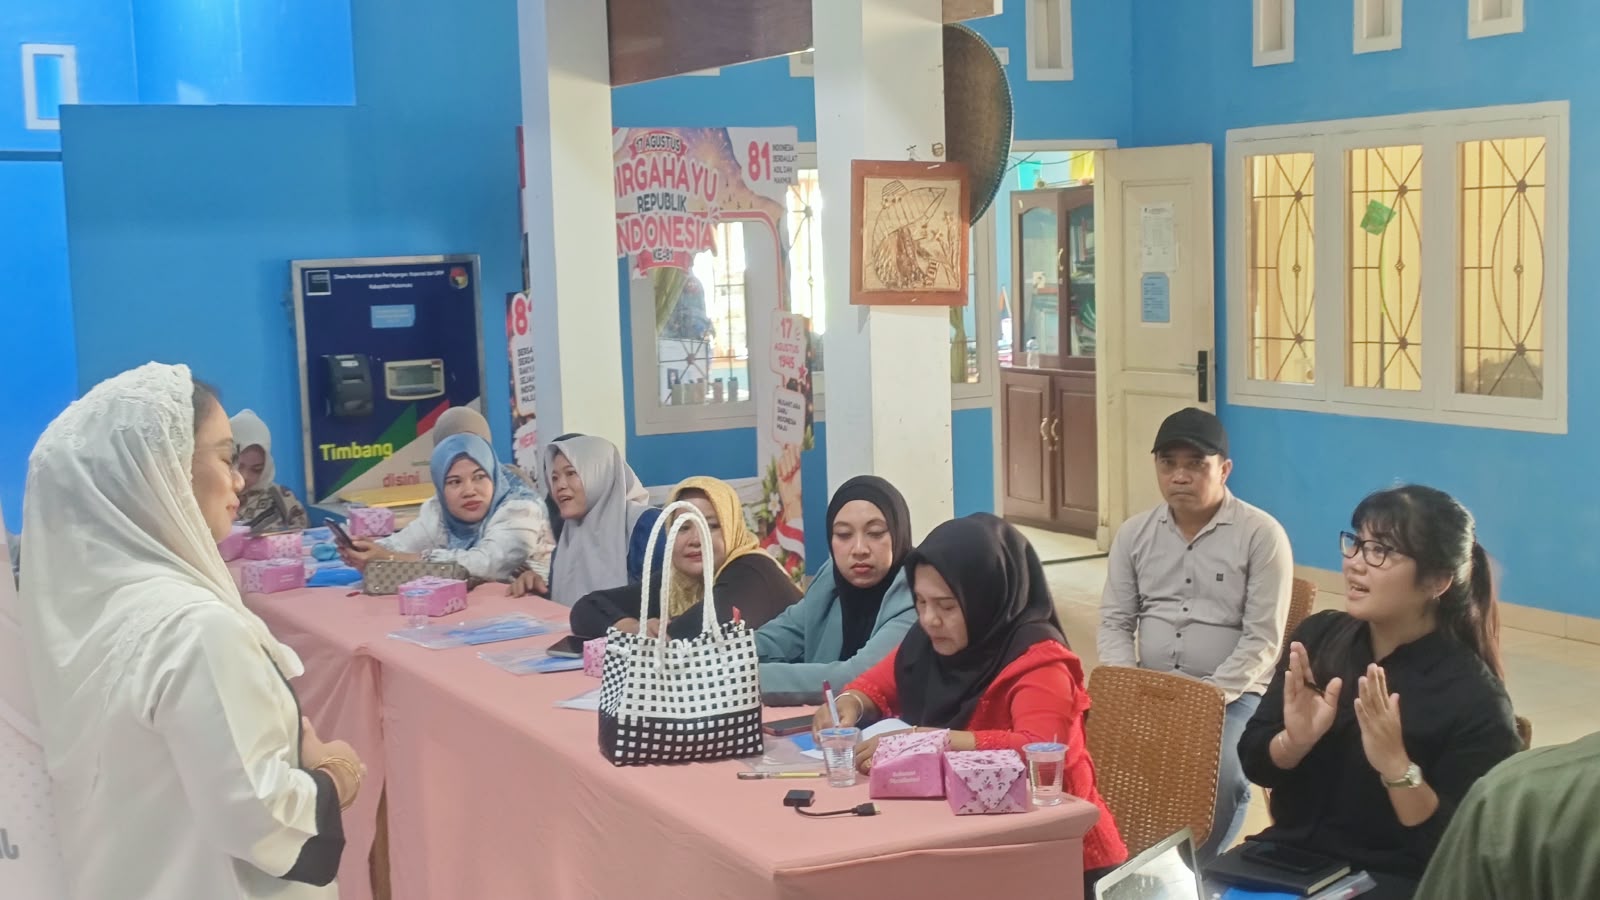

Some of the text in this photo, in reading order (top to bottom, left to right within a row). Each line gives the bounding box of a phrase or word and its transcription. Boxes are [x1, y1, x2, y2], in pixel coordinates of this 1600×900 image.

[645, 135, 681, 151] AGUSTUS
[747, 140, 771, 182] 81
[615, 155, 718, 202] IRGAHAYU
[637, 192, 687, 212] REPUBLIK
[616, 215, 717, 255] NDONESIA
[652, 248, 674, 261] KE-81
[780, 317, 793, 339] 17
[774, 342, 800, 354] AGUSTUS
[778, 355, 796, 369] 1945
[319, 442, 393, 461] Timbang
[382, 471, 420, 488] disini
